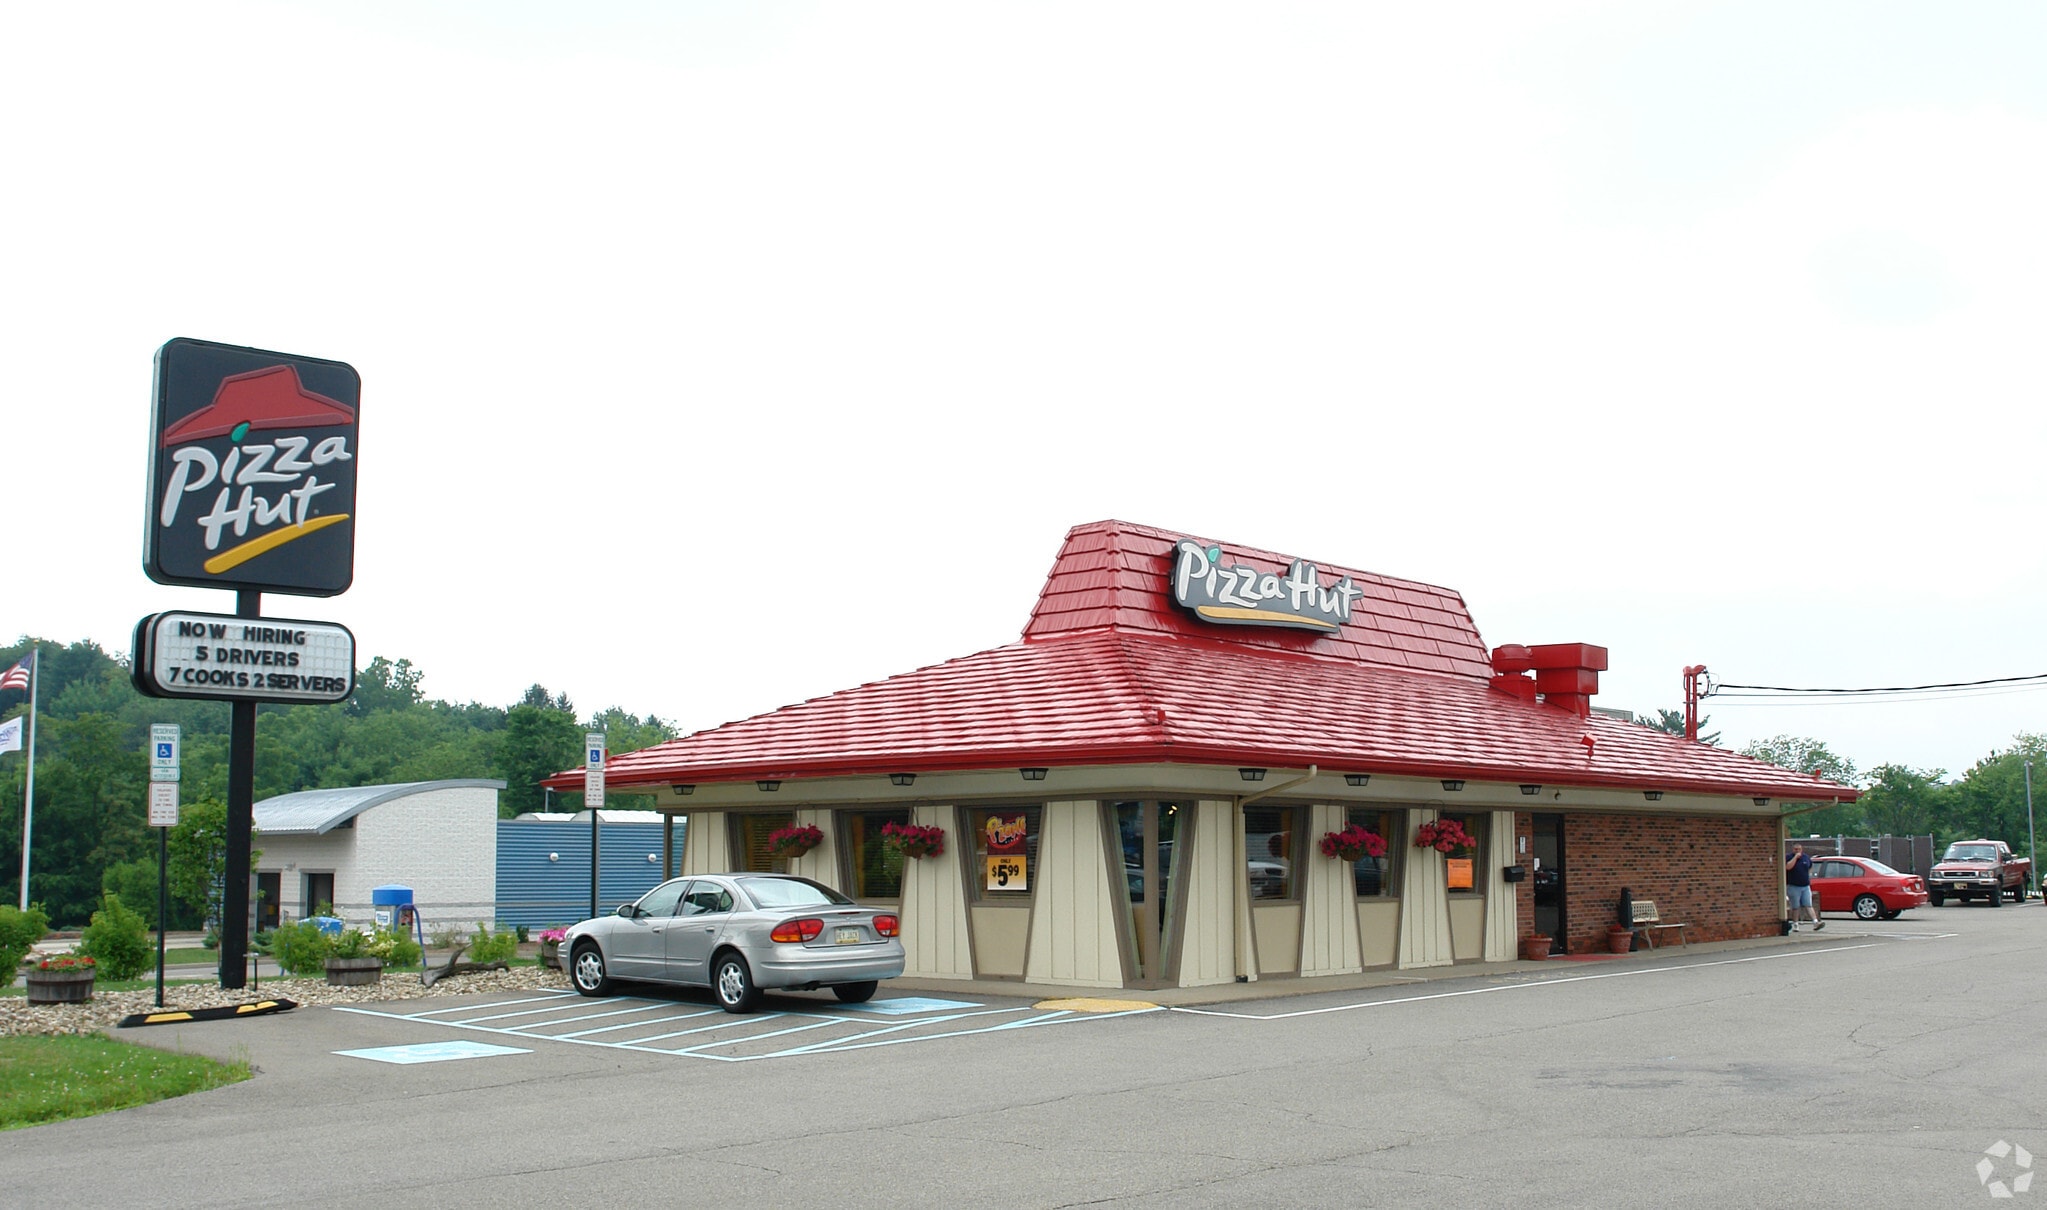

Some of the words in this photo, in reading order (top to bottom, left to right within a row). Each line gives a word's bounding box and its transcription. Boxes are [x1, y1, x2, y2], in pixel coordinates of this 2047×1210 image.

[161, 422, 351, 527] Pizza
[198, 476, 335, 549] Hut
[1179, 542, 1285, 608] Pizza
[1286, 561, 1361, 618] Hut
[179, 621, 227, 639] NOW
[243, 626, 305, 645] HIRING
[195, 646, 208, 661] 5
[216, 648, 299, 666] DRIVERS
[169, 667, 181, 682] 7
[183, 668, 249, 687] COOKS
[254, 673, 265, 688] 2
[266, 673, 346, 692] SERVERS
